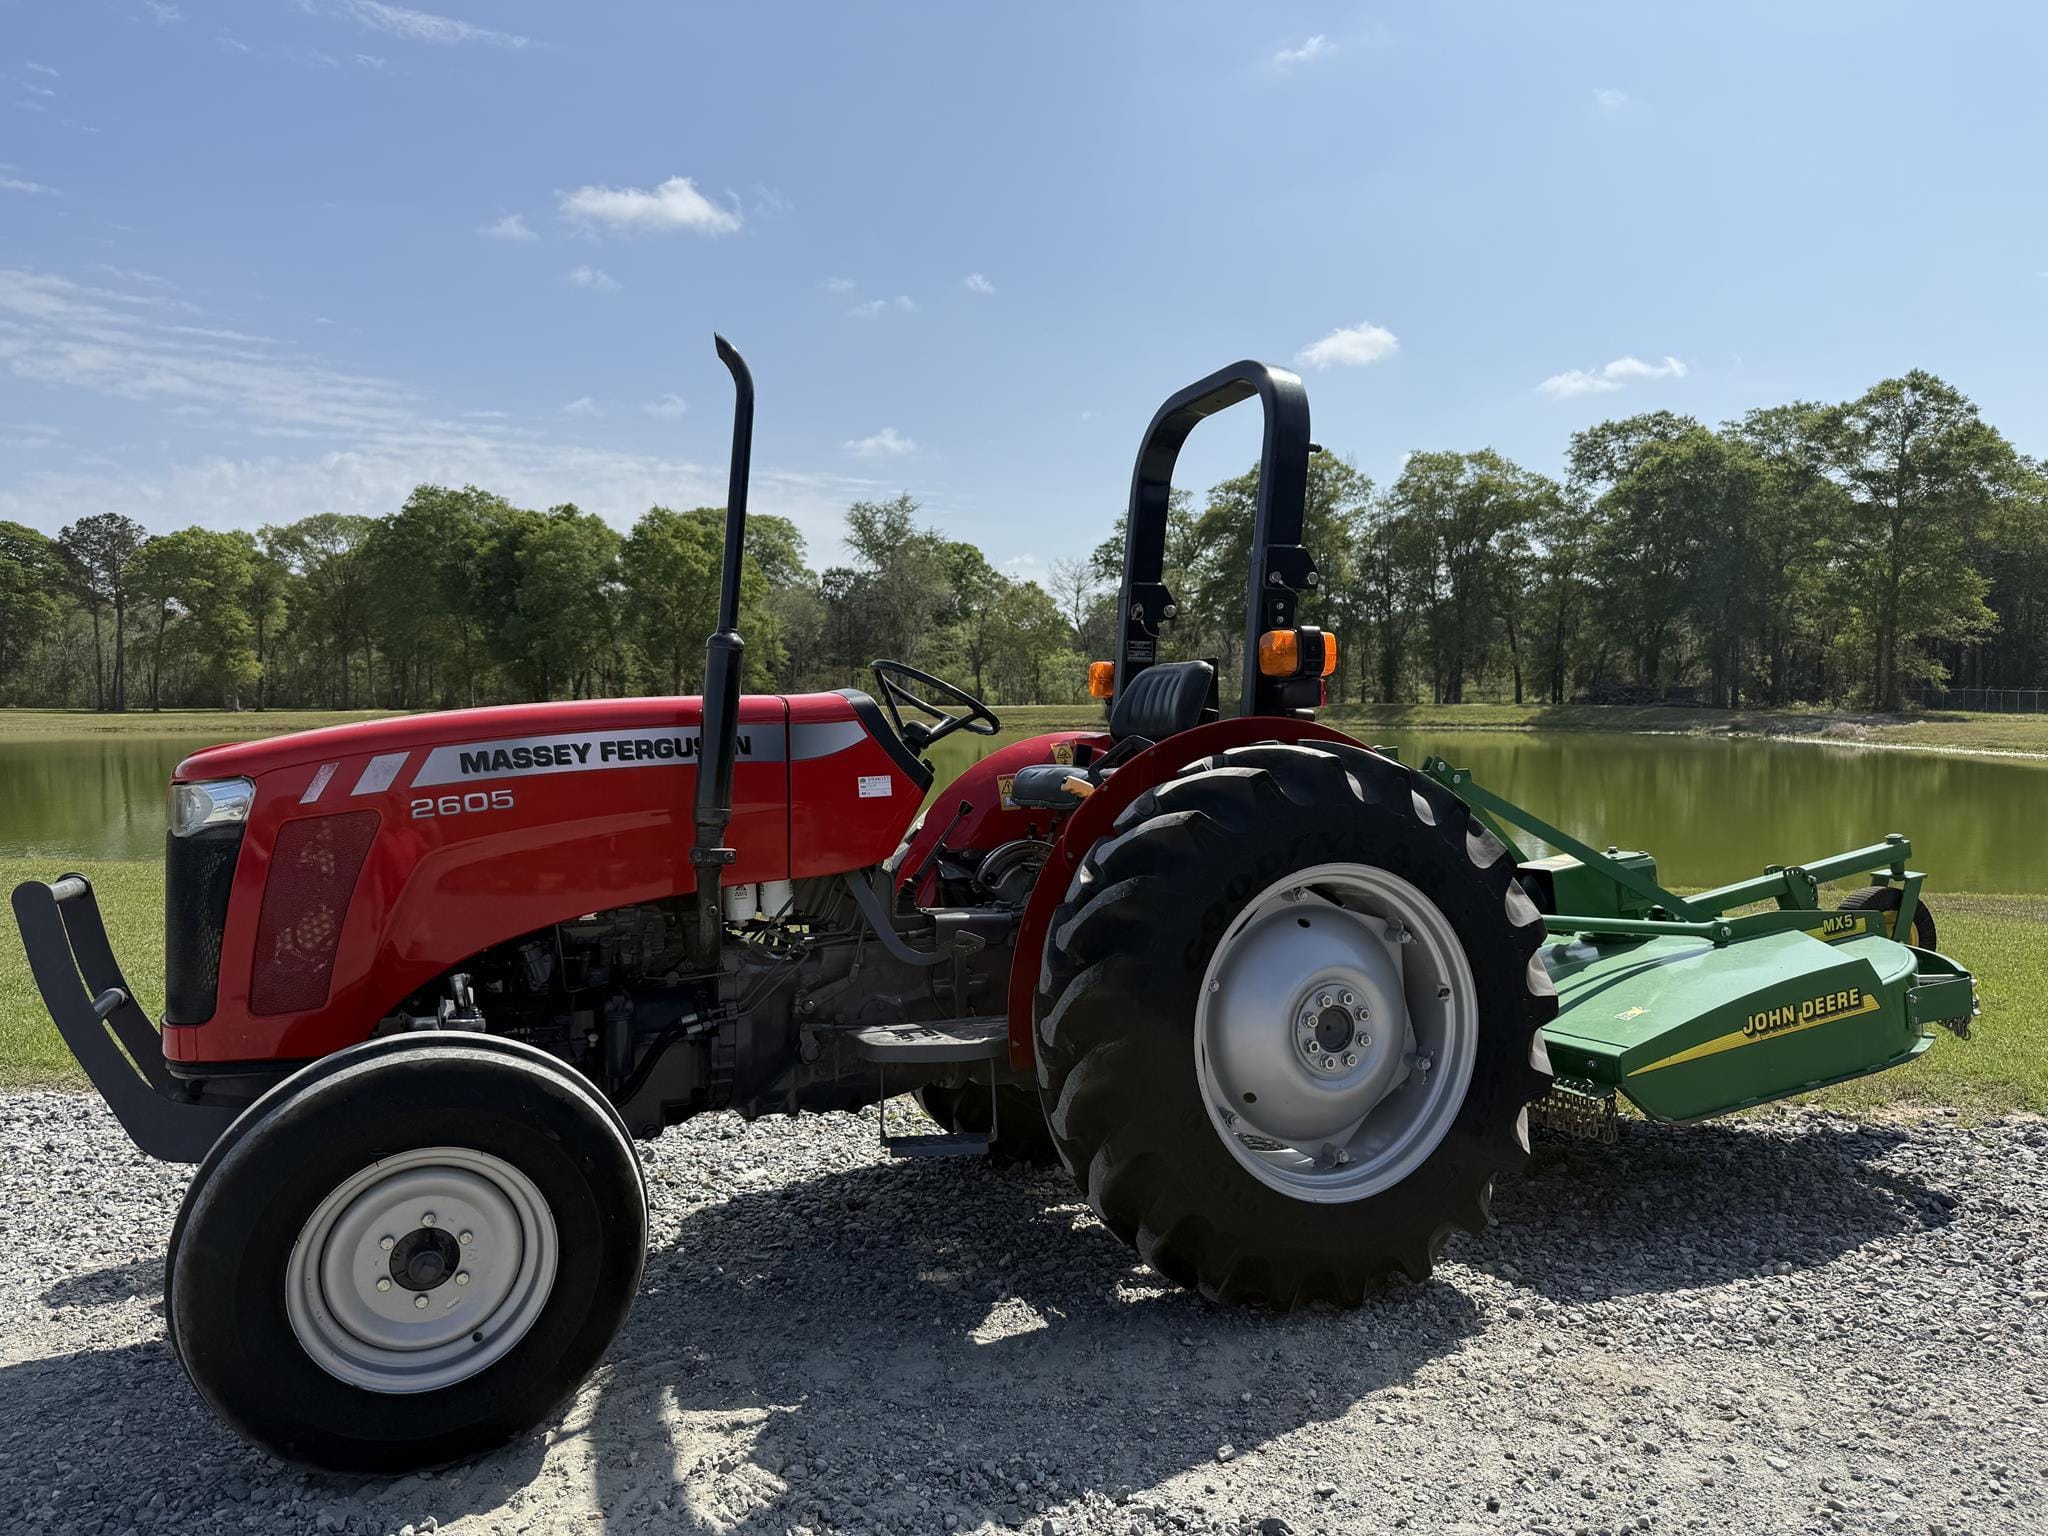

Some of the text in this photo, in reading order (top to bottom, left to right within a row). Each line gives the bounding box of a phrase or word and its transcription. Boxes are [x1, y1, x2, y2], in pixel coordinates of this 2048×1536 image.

[460, 741, 592, 774] MASSEY
[410, 789, 515, 820] 2605
[1822, 913, 1854, 935] MX5
[1743, 987, 1861, 1036] JOHN DEERE
